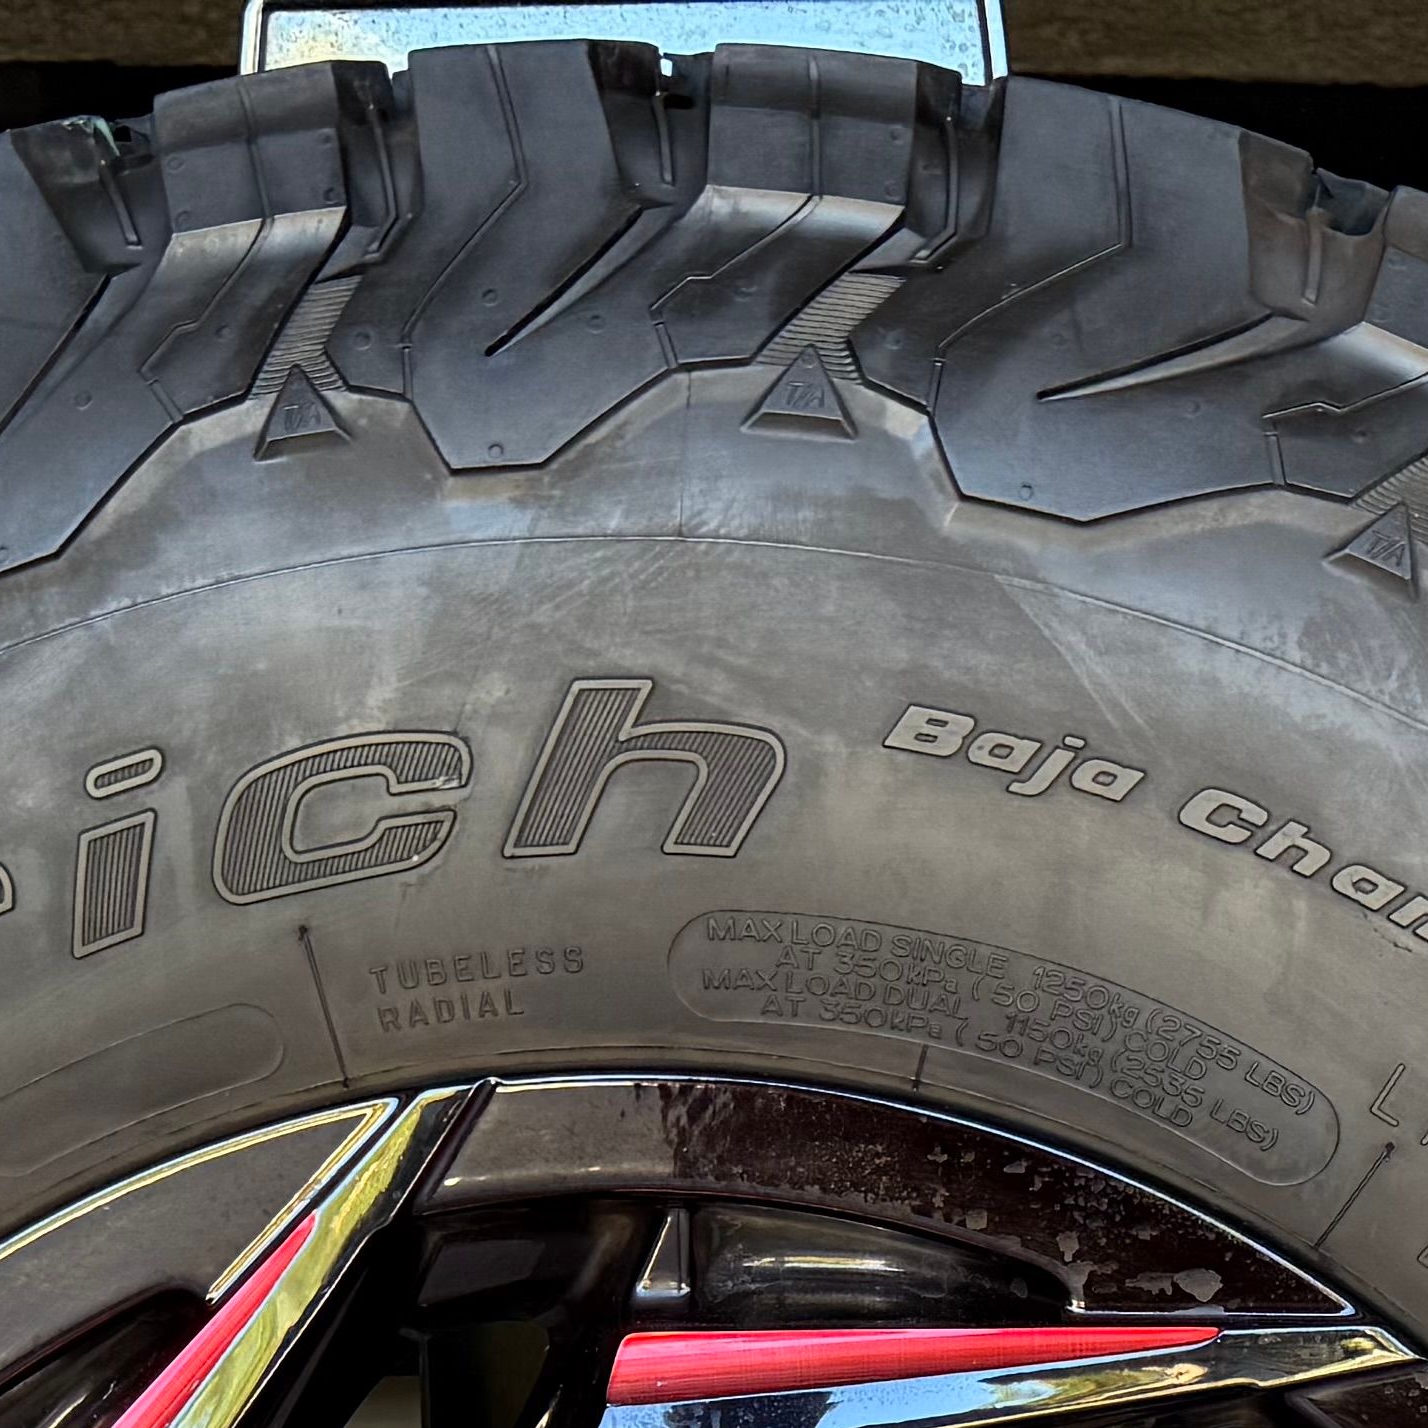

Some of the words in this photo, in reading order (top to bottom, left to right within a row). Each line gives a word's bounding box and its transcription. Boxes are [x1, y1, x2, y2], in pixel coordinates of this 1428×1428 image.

[881, 703, 1145, 805] Baja
[368, 945, 584, 996] TUBELESS
[376, 987, 525, 1034] RADIAL
[706, 915, 784, 945] MAX
[789, 918, 884, 955] LOAD
[888, 932, 1008, 982] SINGLE
[1026, 965, 1140, 1030] 1250kg
[1241, 1060, 1321, 1117] LBS)
[775, 942, 822, 972] AT
[832, 951, 958, 996] 350kPa
[1120, 1027, 1211, 1083] COLD
[700, 967, 777, 994] MAX
[784, 969, 876, 1005] LOAD
[880, 981, 969, 1023] DUAL
[1003, 1010, 1108, 1066] 1150kg
[1206, 1098, 1281, 1153] LBS)
[759, 992, 807, 1019] AT
[817, 999, 943, 1042] 350kPa
[1104, 1077, 1195, 1130] COLD
